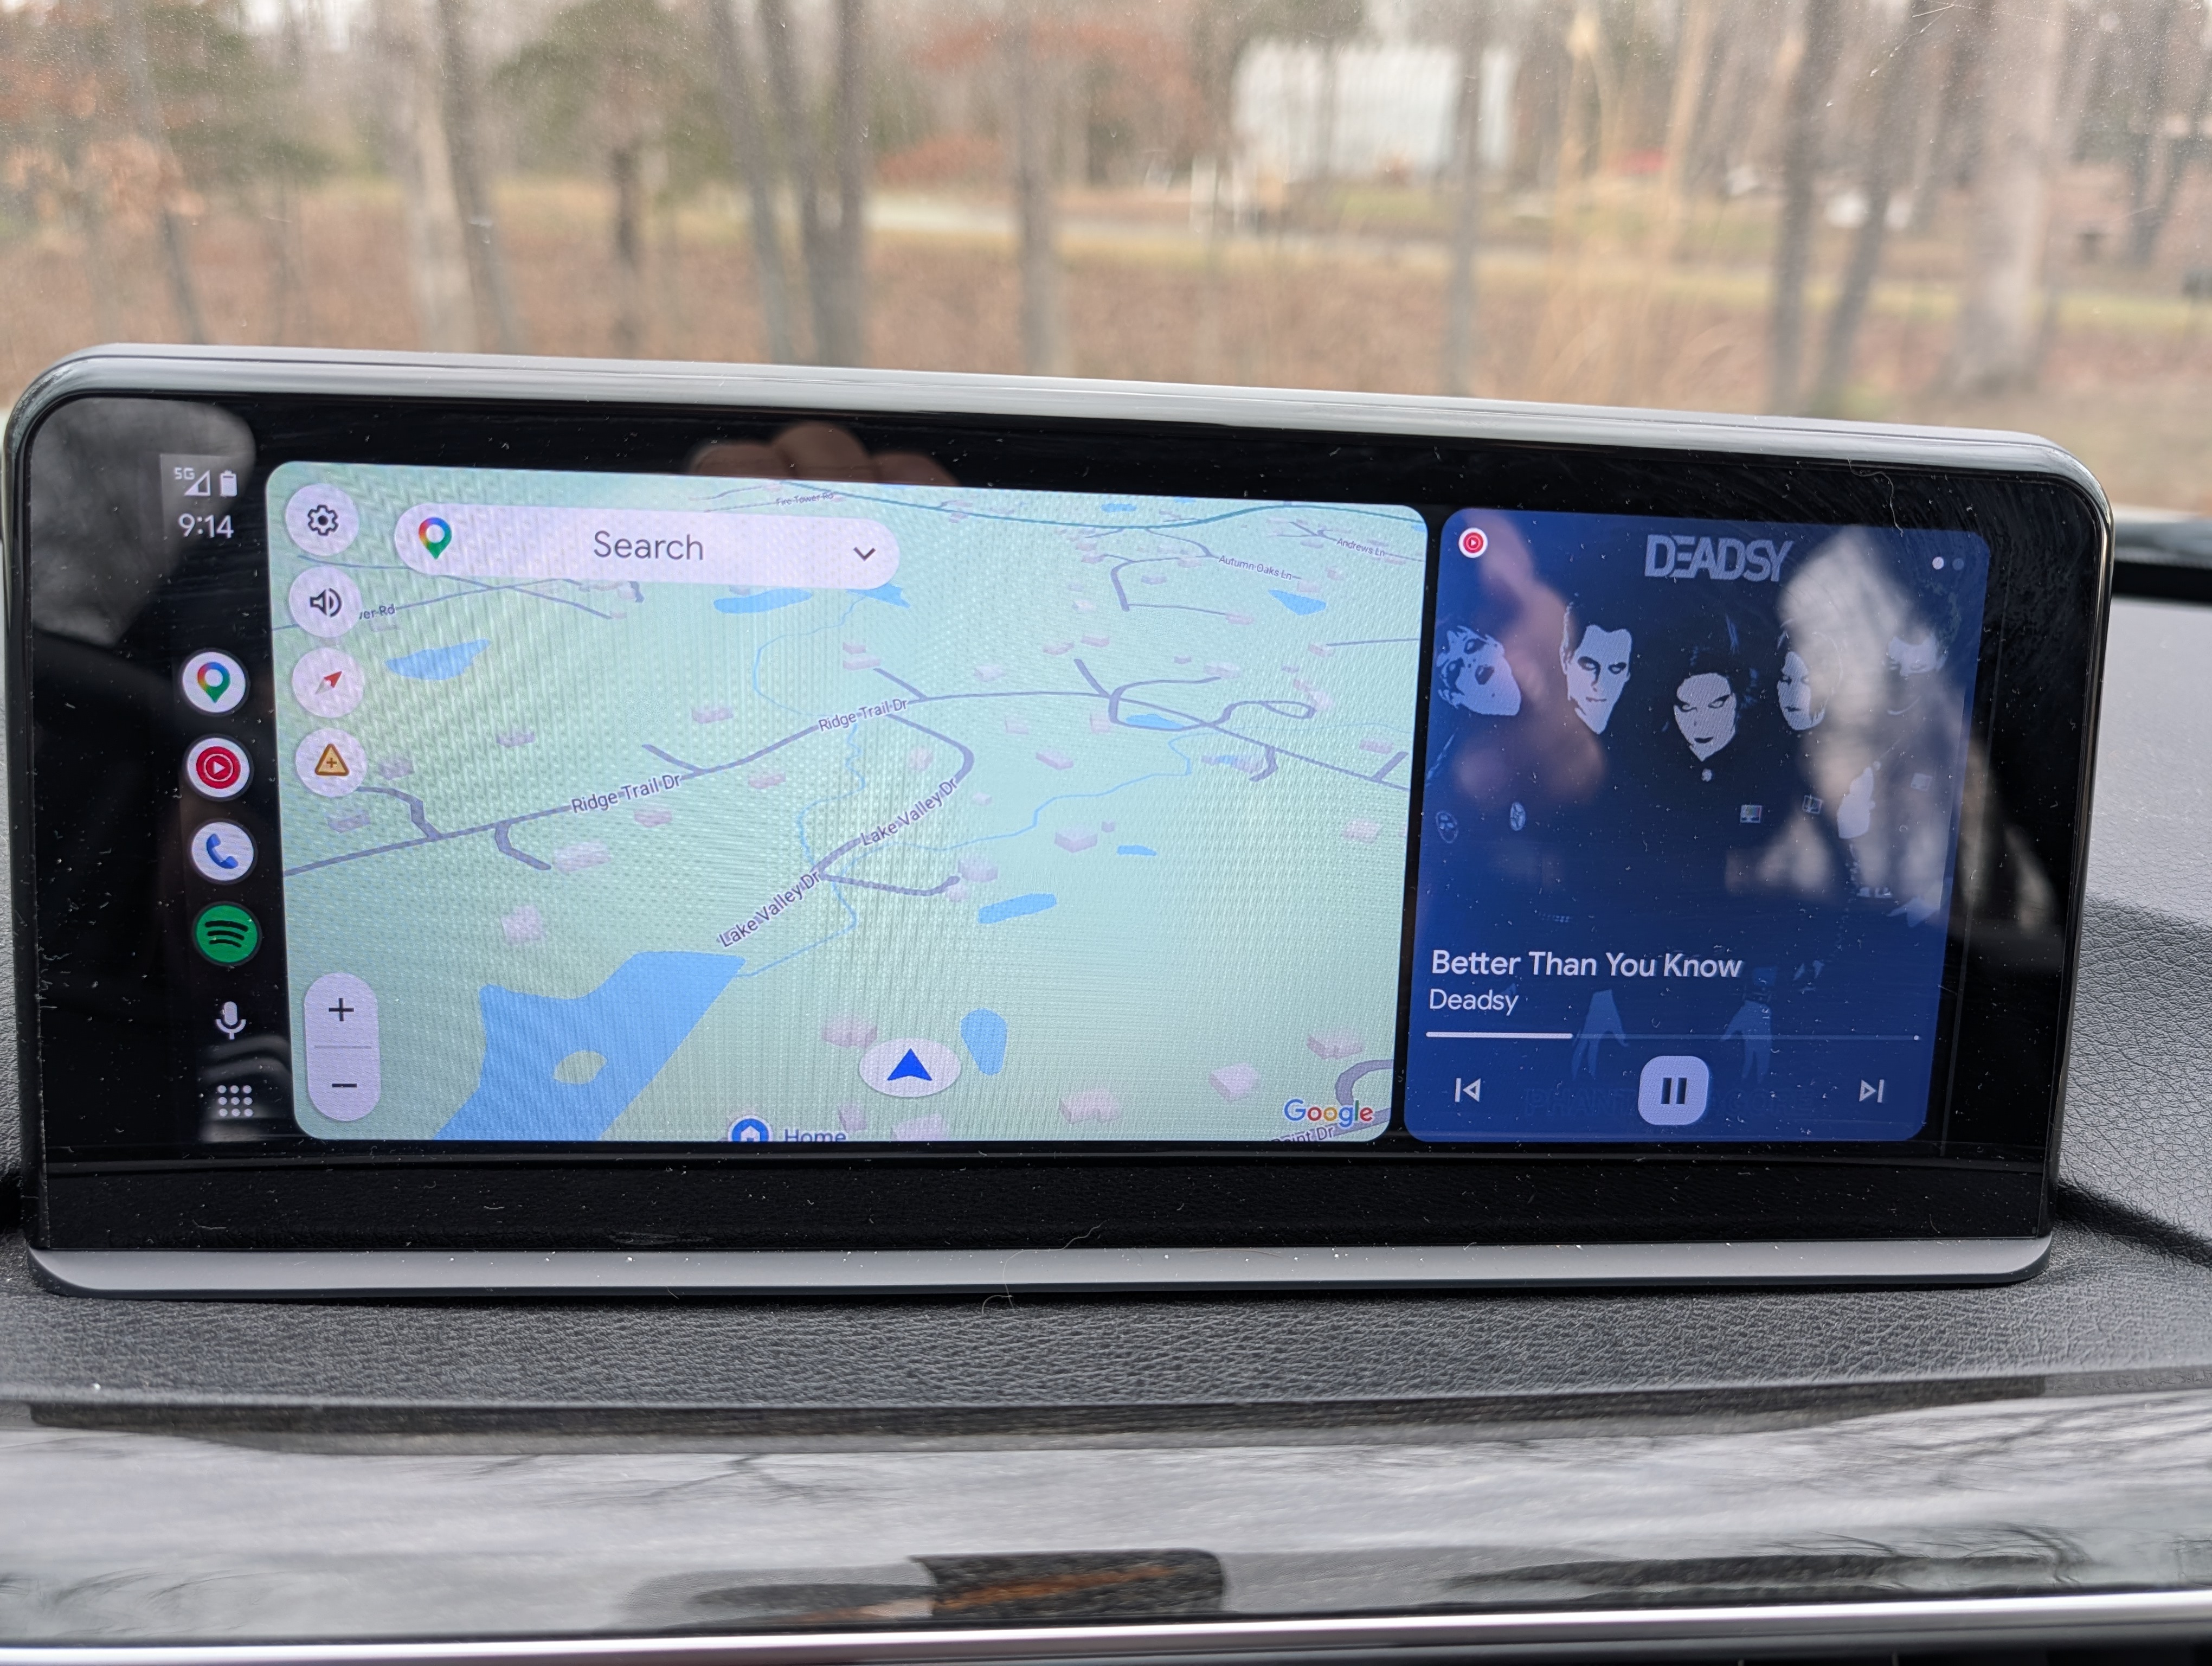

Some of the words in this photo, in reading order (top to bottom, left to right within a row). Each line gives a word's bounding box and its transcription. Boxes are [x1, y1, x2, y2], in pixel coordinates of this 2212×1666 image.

[174, 467, 195, 480] 5G
[794, 495, 820, 503] Tower
[178, 513, 234, 539] 9:14
[593, 531, 704, 561] Search
[1336, 538, 1373, 554] Andrews
[1375, 548, 1385, 556] Ln
[1644, 534, 1795, 582] DEADSY
[1219, 555, 1255, 569] Autumn
[1256, 564, 1279, 577] Oaks
[1281, 570, 1293, 580] Ln
[379, 603, 395, 616] Rd
[818, 713, 857, 731] Ridge
[858, 701, 890, 719] Trail
[892, 699, 908, 711] Dr
[571, 792, 618, 813] Ridge
[621, 777, 659, 799] Trail
[662, 774, 680, 790] Dr
[860, 823, 898, 845] Lake
[897, 792, 942, 825] Valley
[939, 778, 957, 795] Dr
[719, 919, 758, 947] Lake
[755, 885, 802, 920] Valley
[801, 871, 820, 889] Dr
[1432, 950, 1521, 976] Better
[1528, 951, 1596, 976] Than
[1605, 952, 1655, 977] You
[1663, 953, 1742, 978] Know
[1429, 988, 1519, 1016] Deadsy
[1284, 1099, 1373, 1127] Google
[785, 1129, 846, 1142] Home
[1316, 1126, 1333, 1140] Dr
